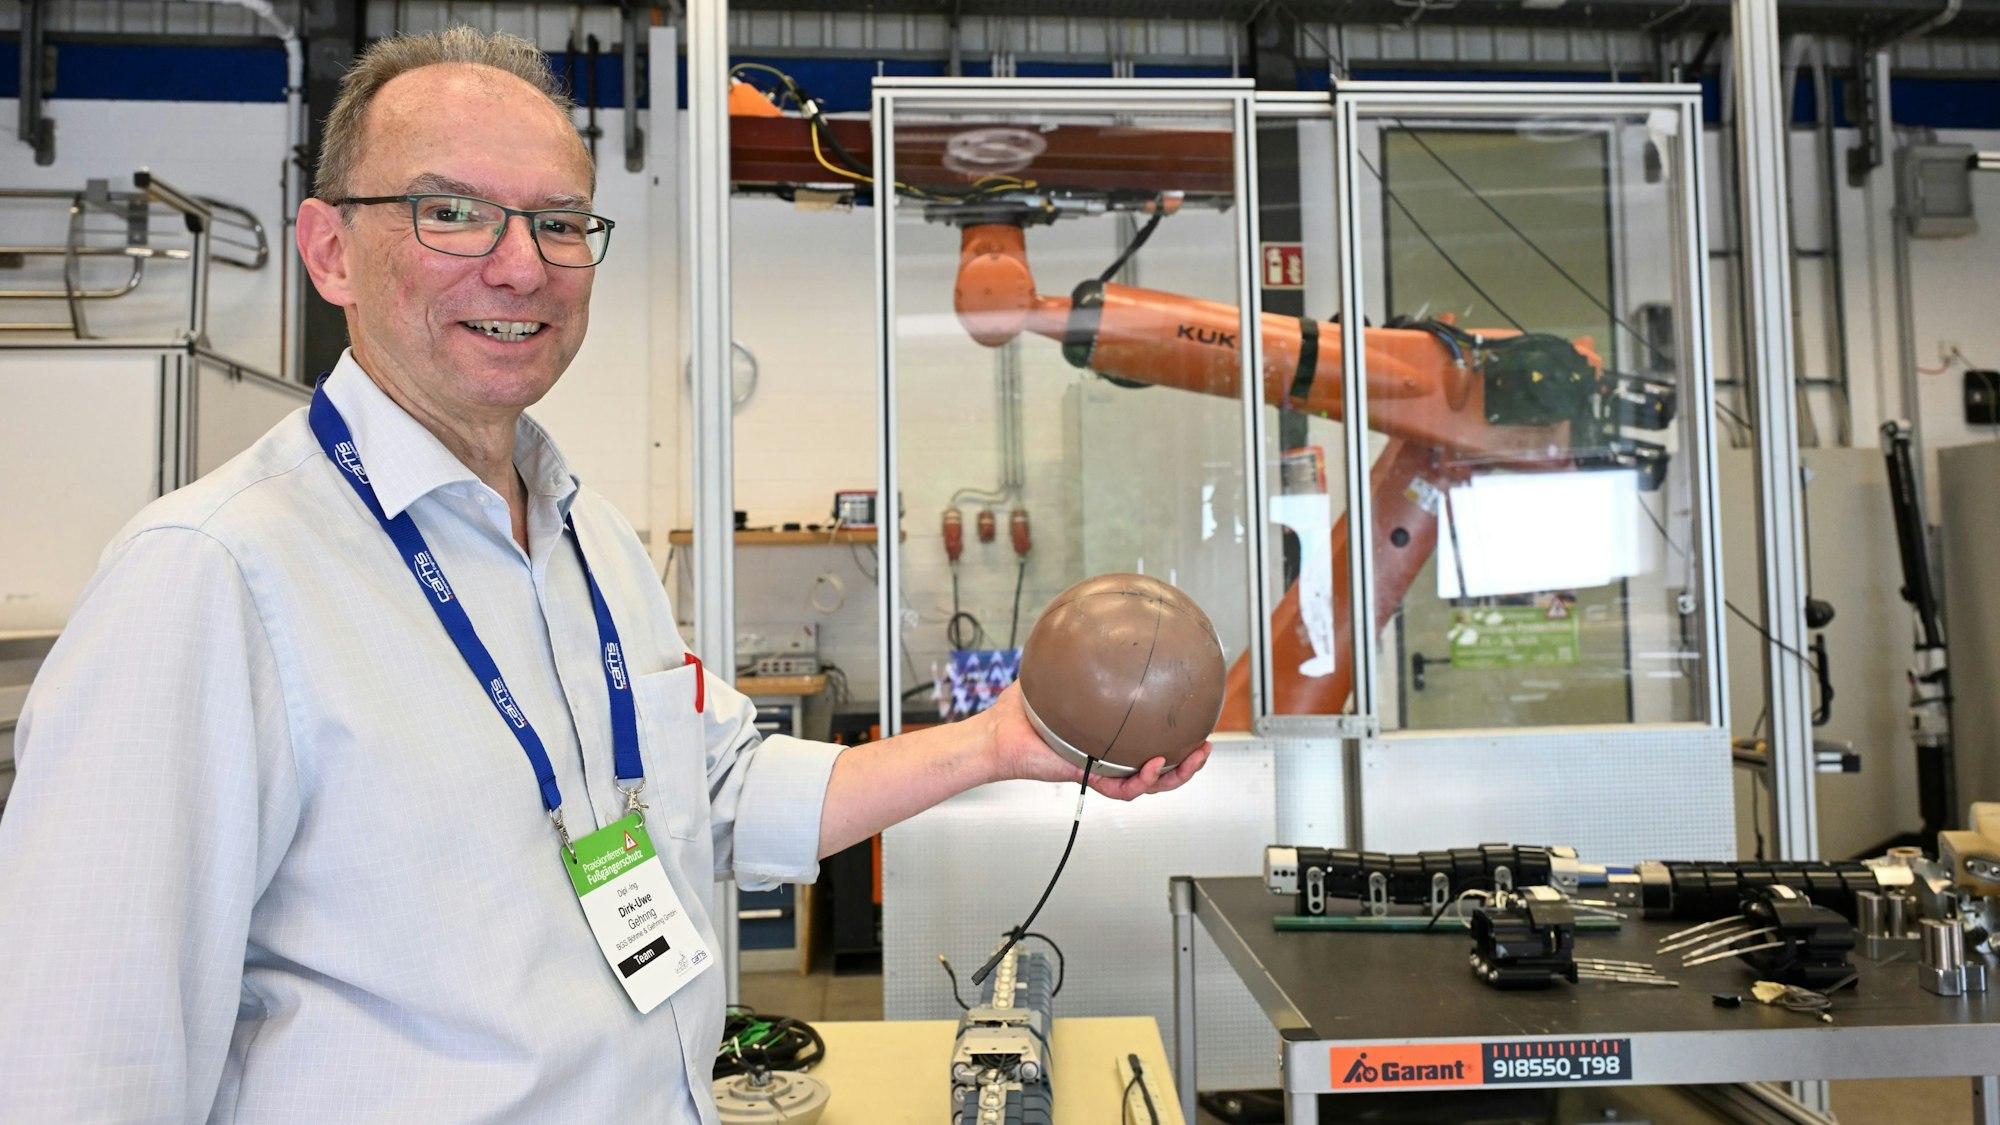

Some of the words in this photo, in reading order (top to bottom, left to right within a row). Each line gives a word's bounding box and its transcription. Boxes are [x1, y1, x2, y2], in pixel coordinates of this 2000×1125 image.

[1177, 324, 1238, 348] KUK
[335, 441, 370, 485] carhs
[414, 552, 450, 603] carhs
[606, 642, 624, 690] carhs
[490, 678, 524, 728] carhs
[582, 846, 625, 873] Praxiskonferenz
[586, 850, 643, 885] Fußgängerschutz
[618, 893, 652, 918] Dirk-Uwe
[628, 908, 658, 930] Gehring
[616, 940, 628, 951] BGS
[627, 931, 644, 944] Böhme
[647, 918, 665, 931] Gehring
[663, 908, 677, 920] GmbH
[633, 948, 655, 965] Team
[1381, 1060, 1465, 1082] Garant
[1493, 1055, 1621, 1080] 918550_T98
